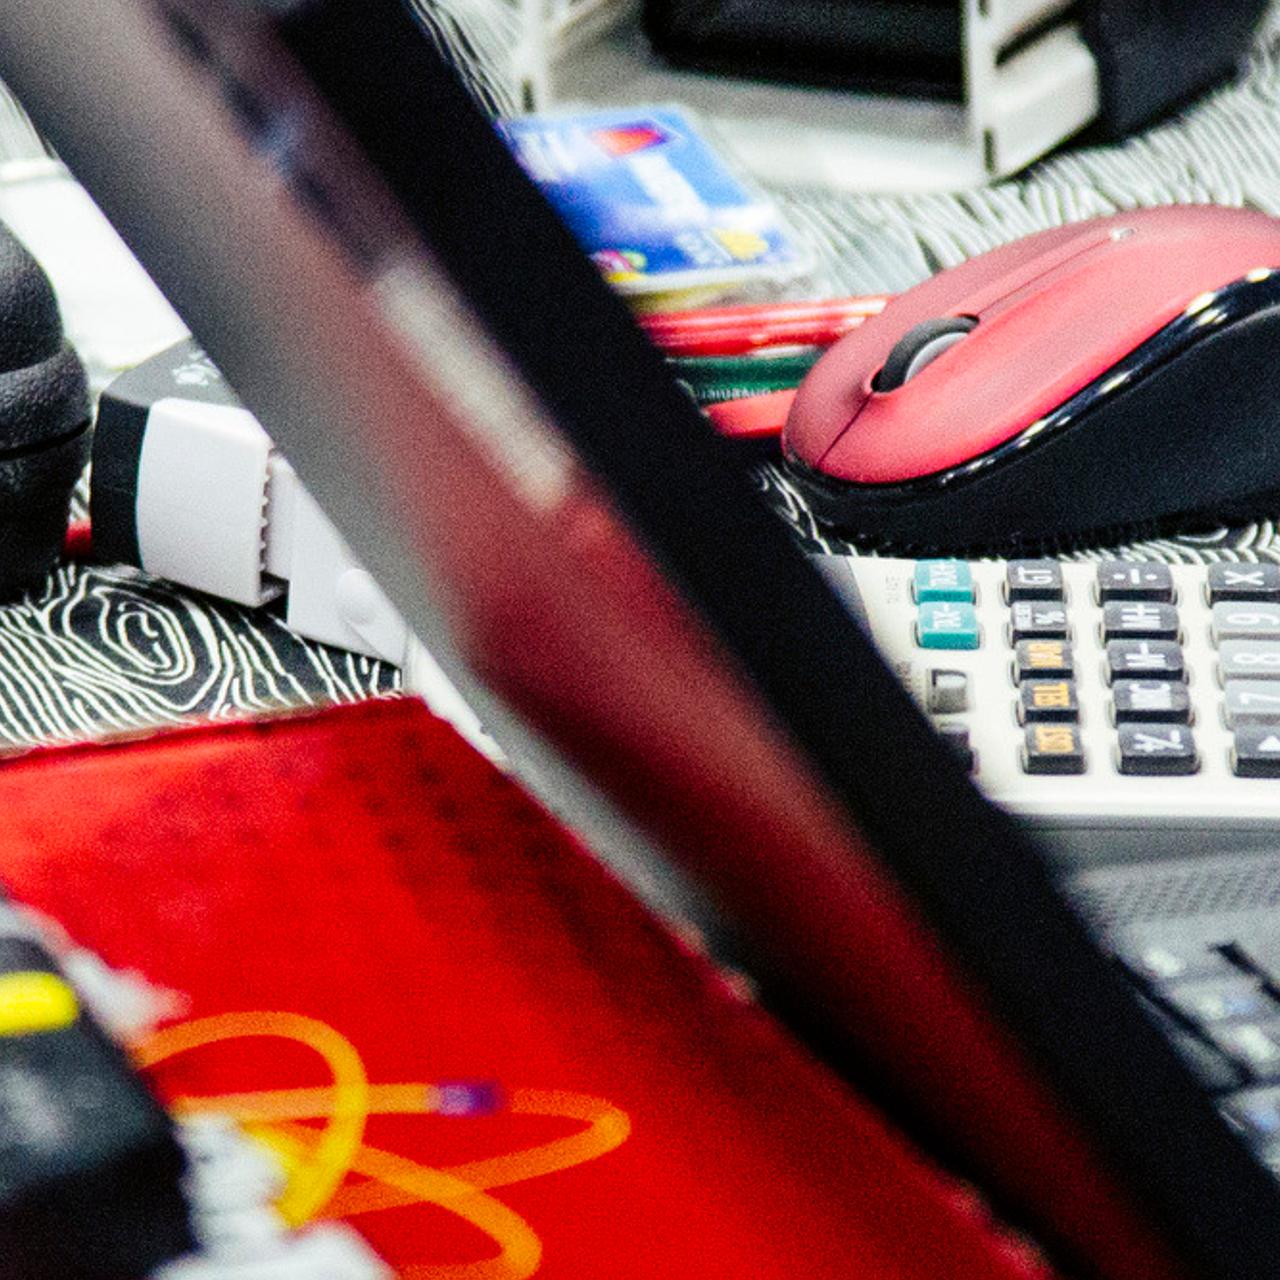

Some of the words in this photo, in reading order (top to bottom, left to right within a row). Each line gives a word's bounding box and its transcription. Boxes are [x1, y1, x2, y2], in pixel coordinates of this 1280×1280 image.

[1017, 566, 1054, 585] GT
[1121, 604, 1161, 628] M+
[1226, 612, 1280, 626] 9
[1125, 642, 1167, 668] M-
[1033, 682, 1070, 706] SELL
